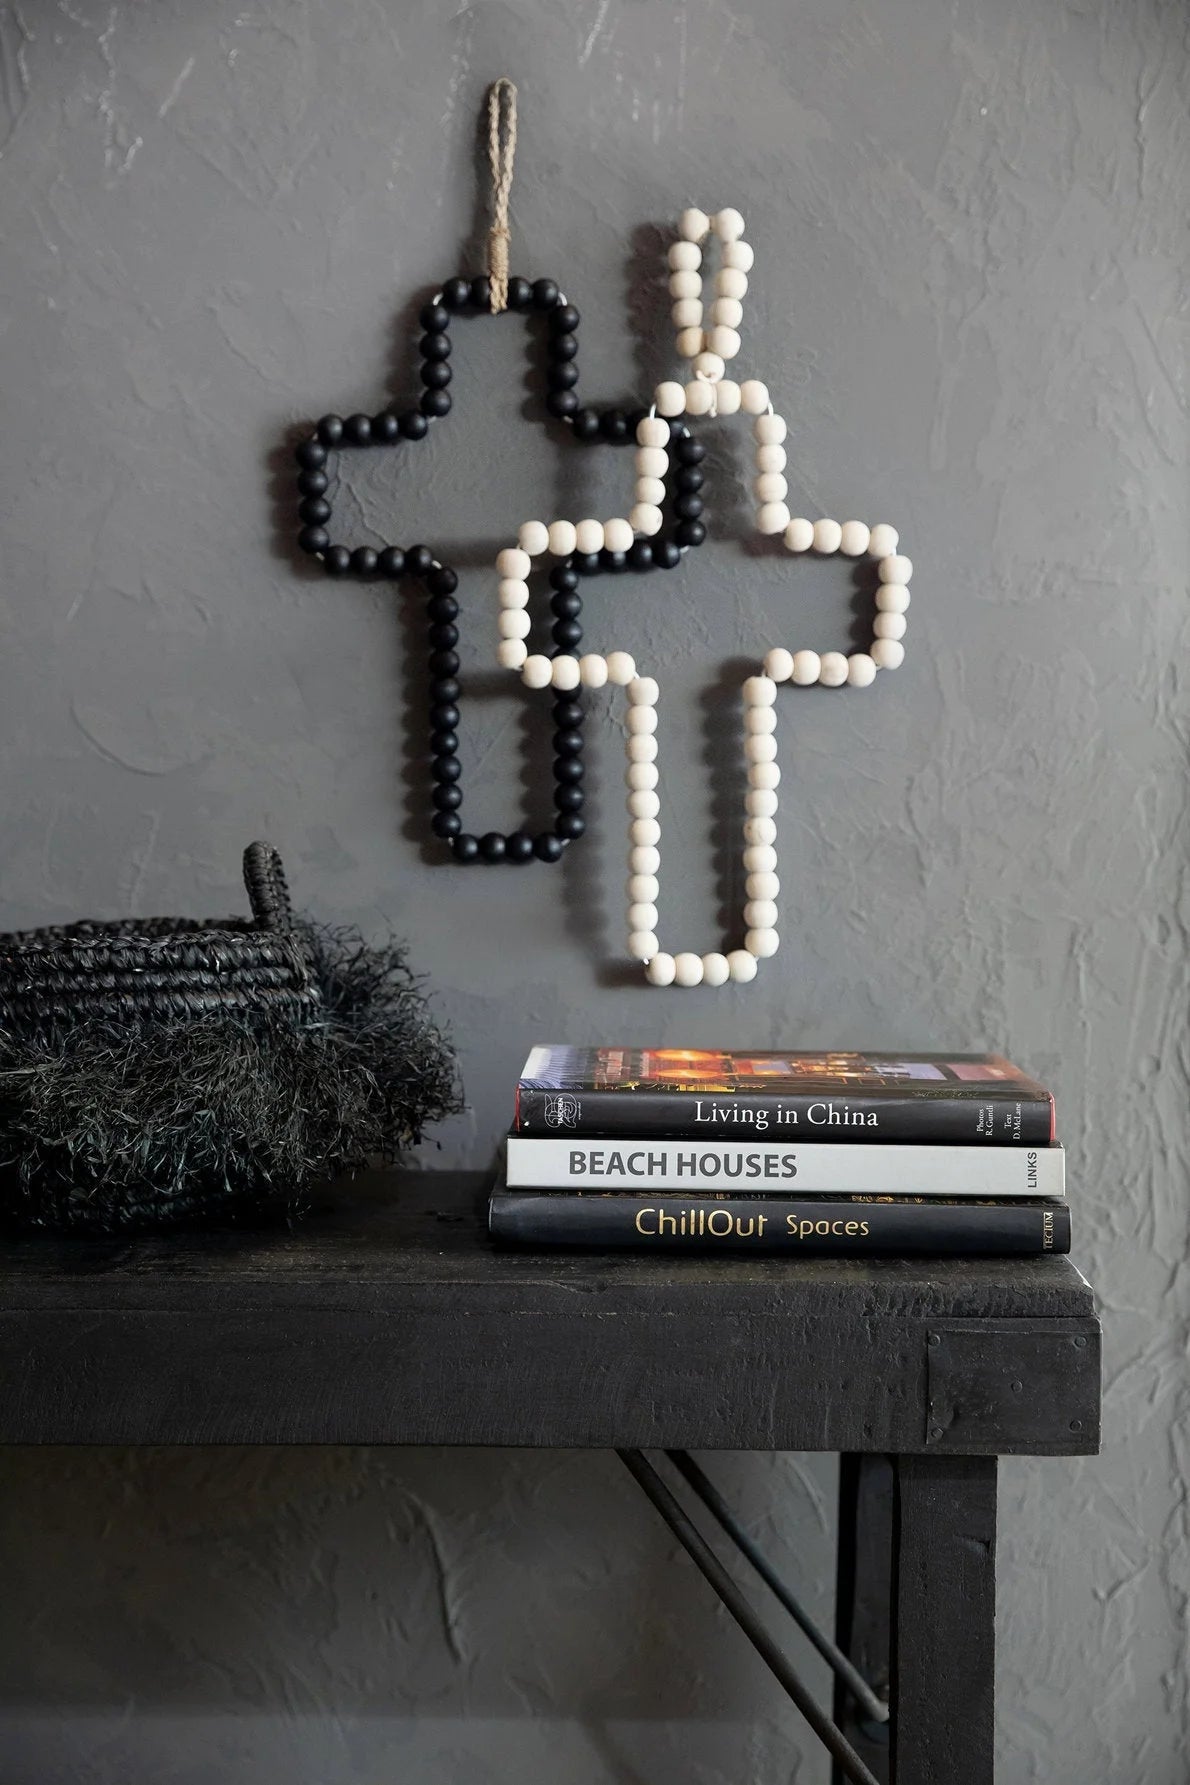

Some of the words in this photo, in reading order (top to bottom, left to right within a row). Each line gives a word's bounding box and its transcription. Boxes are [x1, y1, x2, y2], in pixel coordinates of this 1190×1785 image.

[694, 1101, 770, 1130] Living
[776, 1104, 799, 1124] in
[807, 1103, 879, 1126] China
[976, 1109, 984, 1132] Photos
[1003, 1114, 1012, 1129] Text
[1013, 1103, 1022, 1131] McLane
[1012, 1131, 1021, 1139] D.
[569, 1151, 667, 1176] BEACH
[677, 1153, 798, 1178] HOUSES
[1027, 1152, 1037, 1188] LINKS
[635, 1208, 768, 1236] ChillOut
[786, 1214, 869, 1239] Spaces
